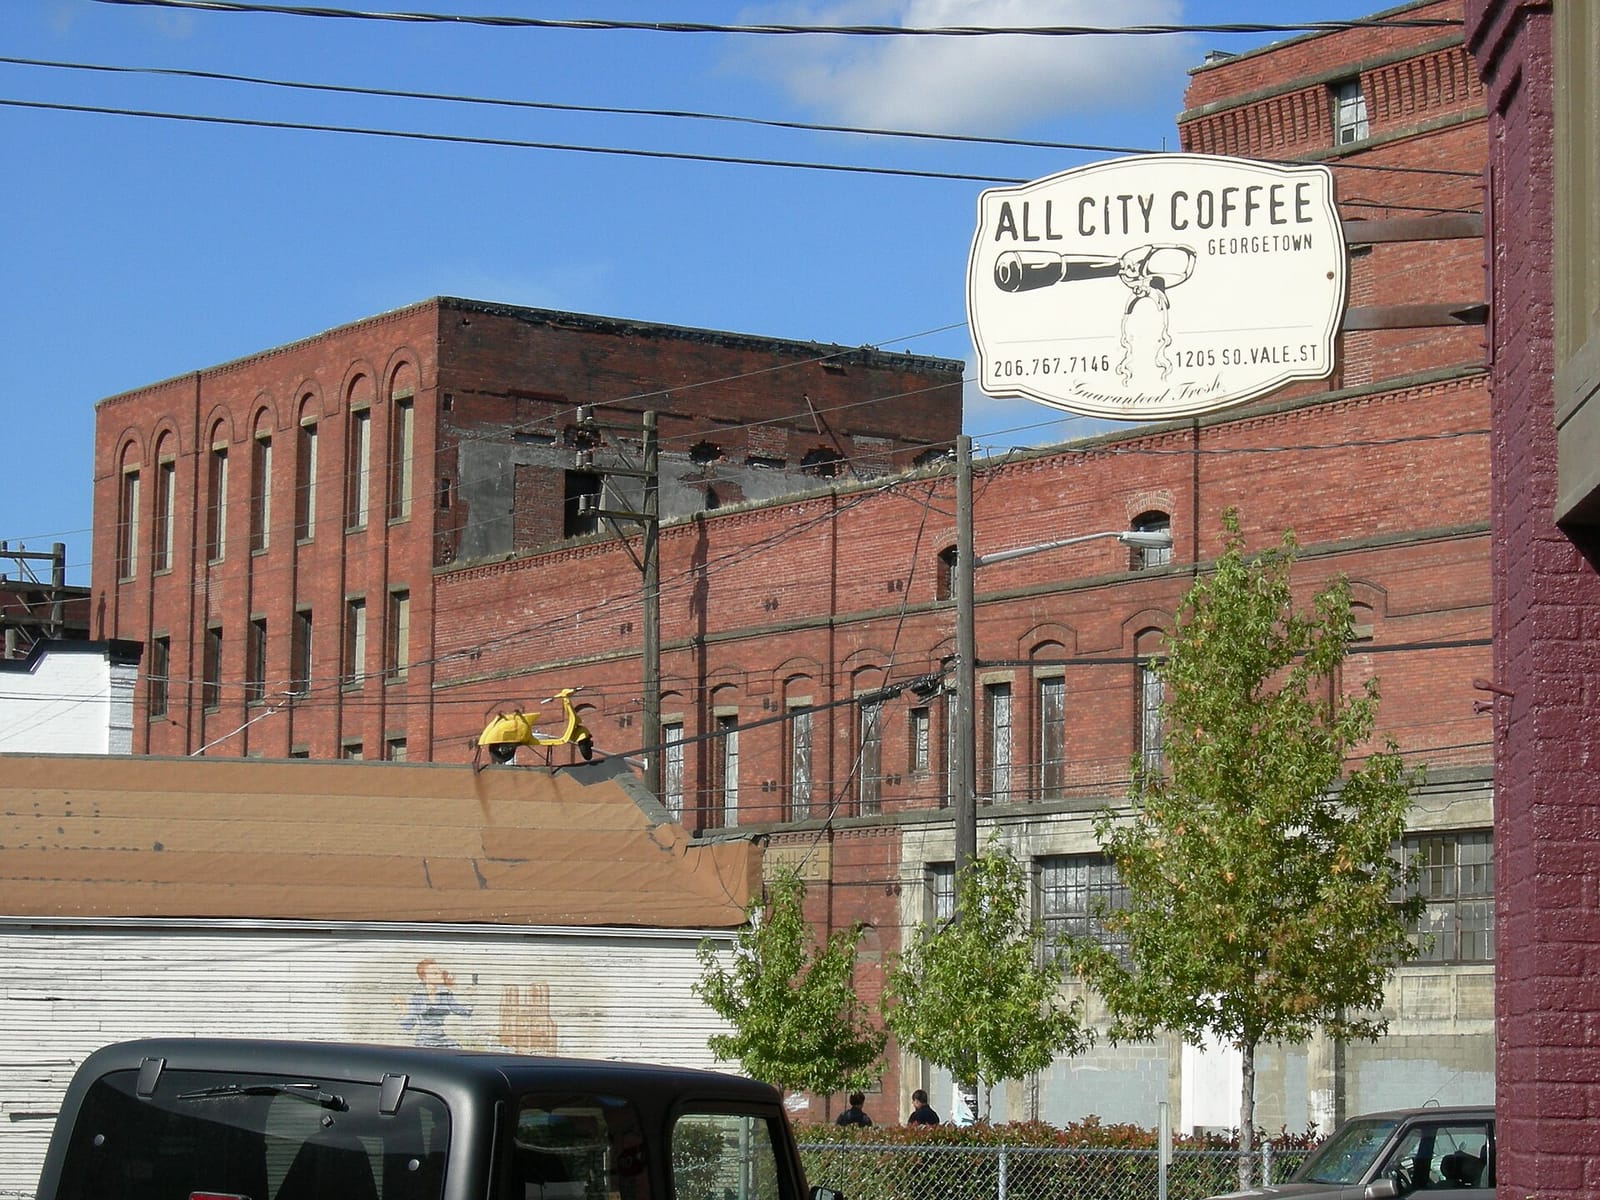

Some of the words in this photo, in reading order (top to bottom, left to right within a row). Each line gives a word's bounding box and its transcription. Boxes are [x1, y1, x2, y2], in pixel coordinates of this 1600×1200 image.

[995, 200, 1063, 241] ALL
[1079, 193, 1154, 236] CITY
[1171, 182, 1313, 231] COFFEE
[1208, 234, 1312, 256] GEORGETOWN
[994, 354, 1109, 378] 206.767.7146
[1175, 349, 1215, 368] 1205
[1069, 379, 1170, 404] Guaranteed
[1173, 372, 1226, 401] Fresh
